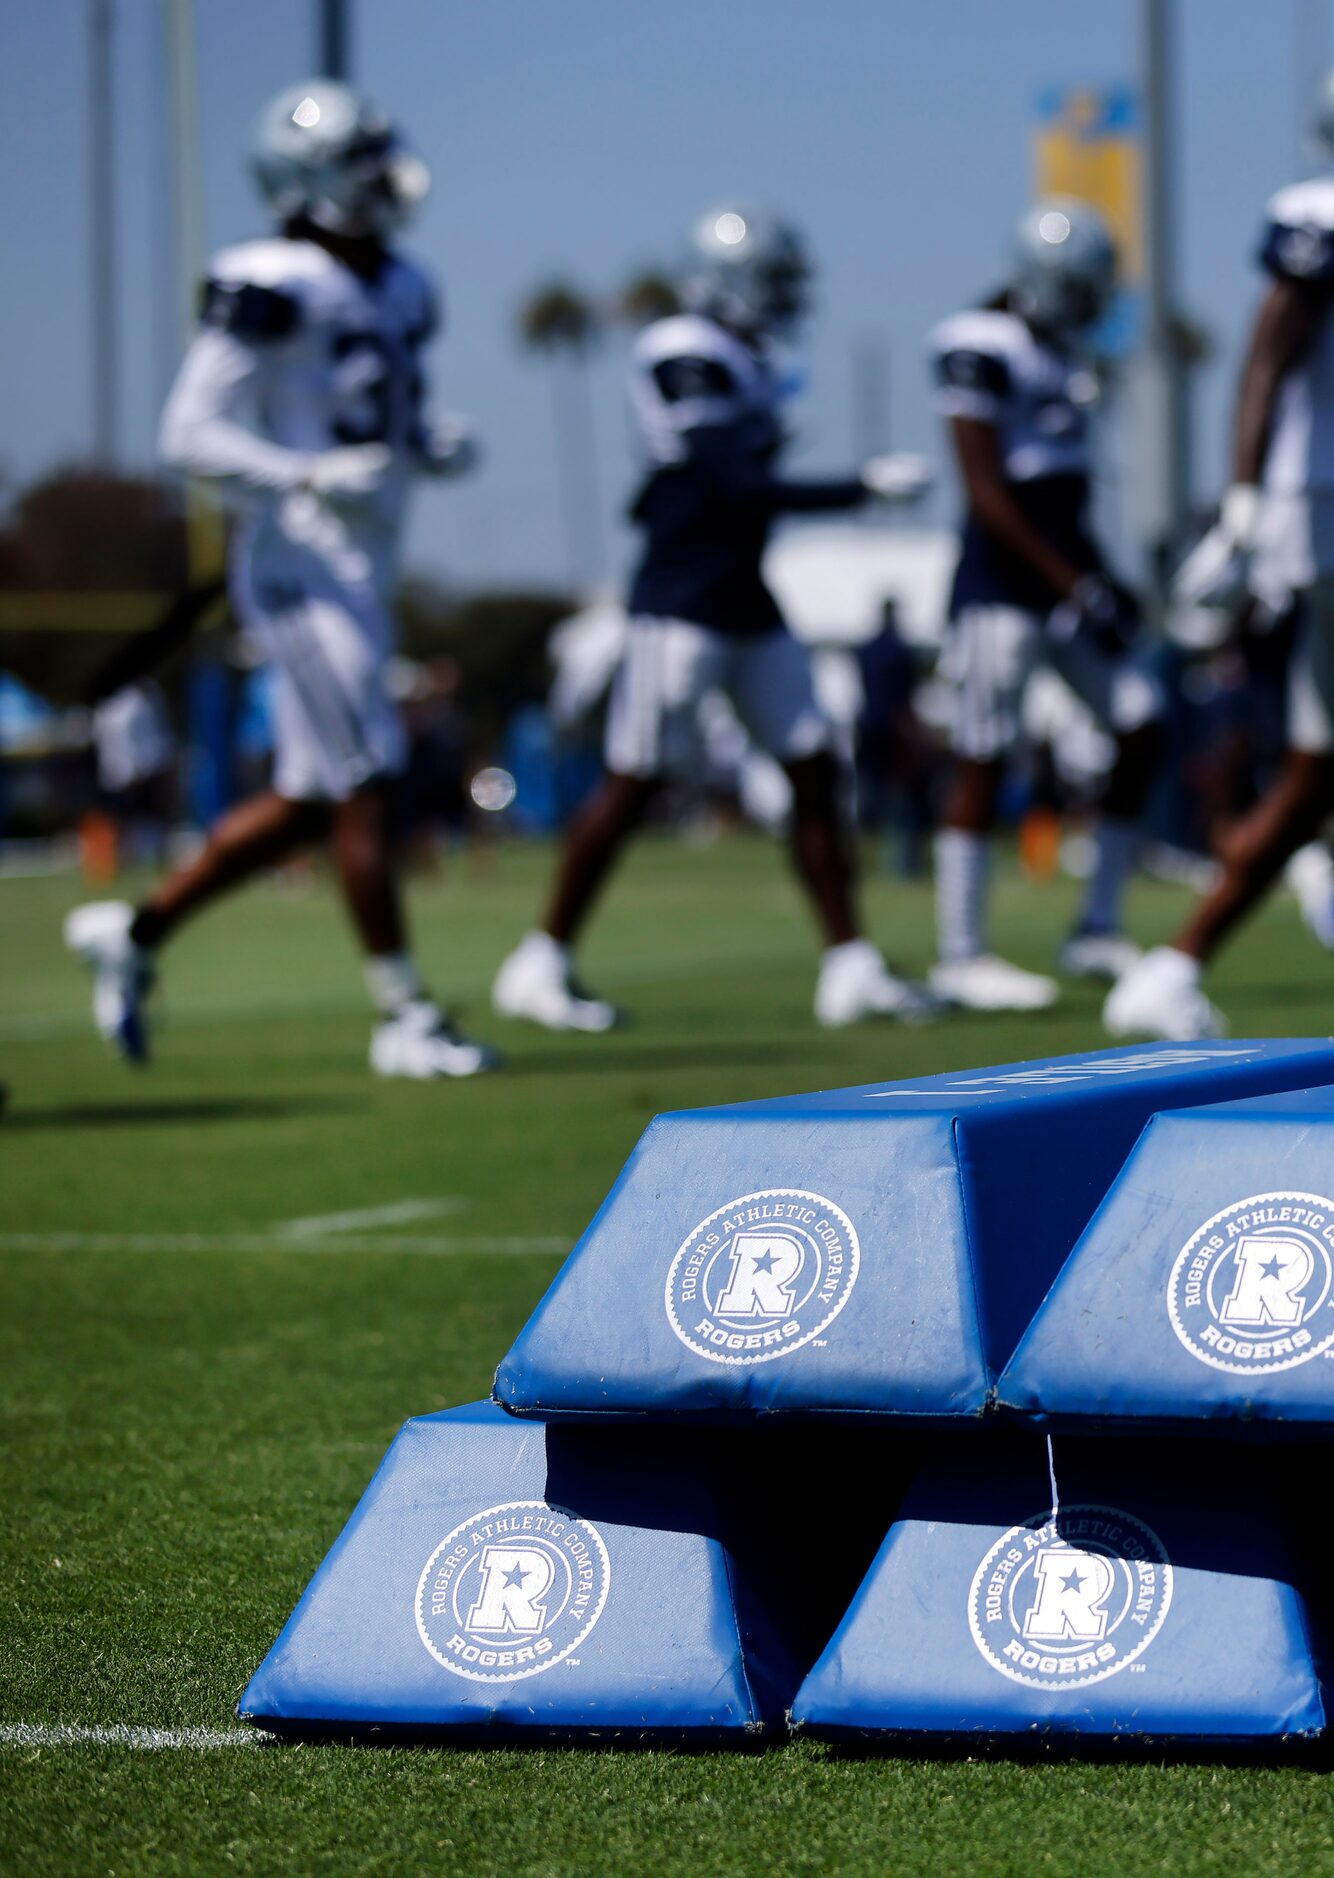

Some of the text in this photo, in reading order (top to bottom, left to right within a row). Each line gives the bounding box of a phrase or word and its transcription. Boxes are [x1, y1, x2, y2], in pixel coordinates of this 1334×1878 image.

[682, 1203, 844, 1304] ROGERS ATHLETIC COMPANY
[713, 1232, 805, 1317] R
[1185, 1235, 1225, 1308] ROGERS
[1225, 1206, 1325, 1238] ATHLETIC
[1219, 1235, 1315, 1327] R
[694, 1318, 801, 1349] ROGERS
[1199, 1324, 1312, 1360] ROGERS
[432, 1515, 594, 1620] ROGERS ATHLETIC COMPANY
[464, 1545, 556, 1634] R
[986, 1519, 1155, 1627] ROGERS ATHLETIC COMPANY
[1022, 1548, 1115, 1641] R
[445, 1633, 553, 1667] ROGERS
[1002, 1639, 1116, 1674] ROGERS
